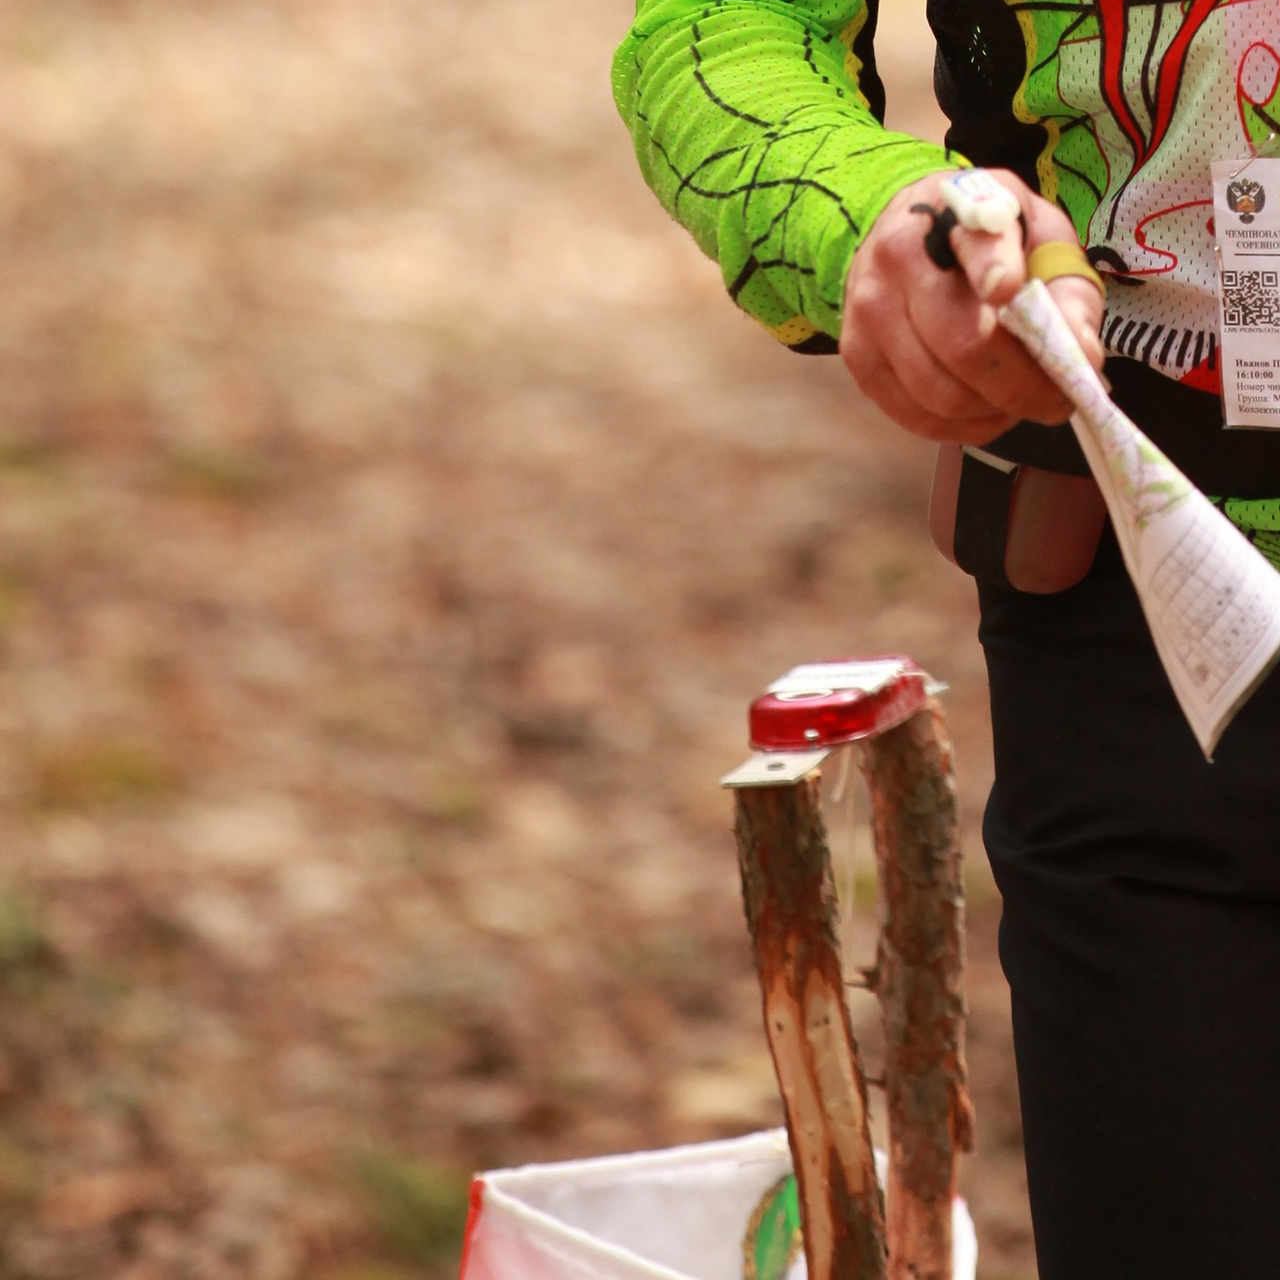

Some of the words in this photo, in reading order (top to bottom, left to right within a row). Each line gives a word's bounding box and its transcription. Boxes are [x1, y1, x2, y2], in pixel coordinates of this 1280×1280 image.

[1236, 359, 1270, 368] Иванов
[1236, 371, 1274, 379] 16:10:00
[1236, 383, 1266, 393] Номер
[1237, 394, 1271, 404] Группа:
